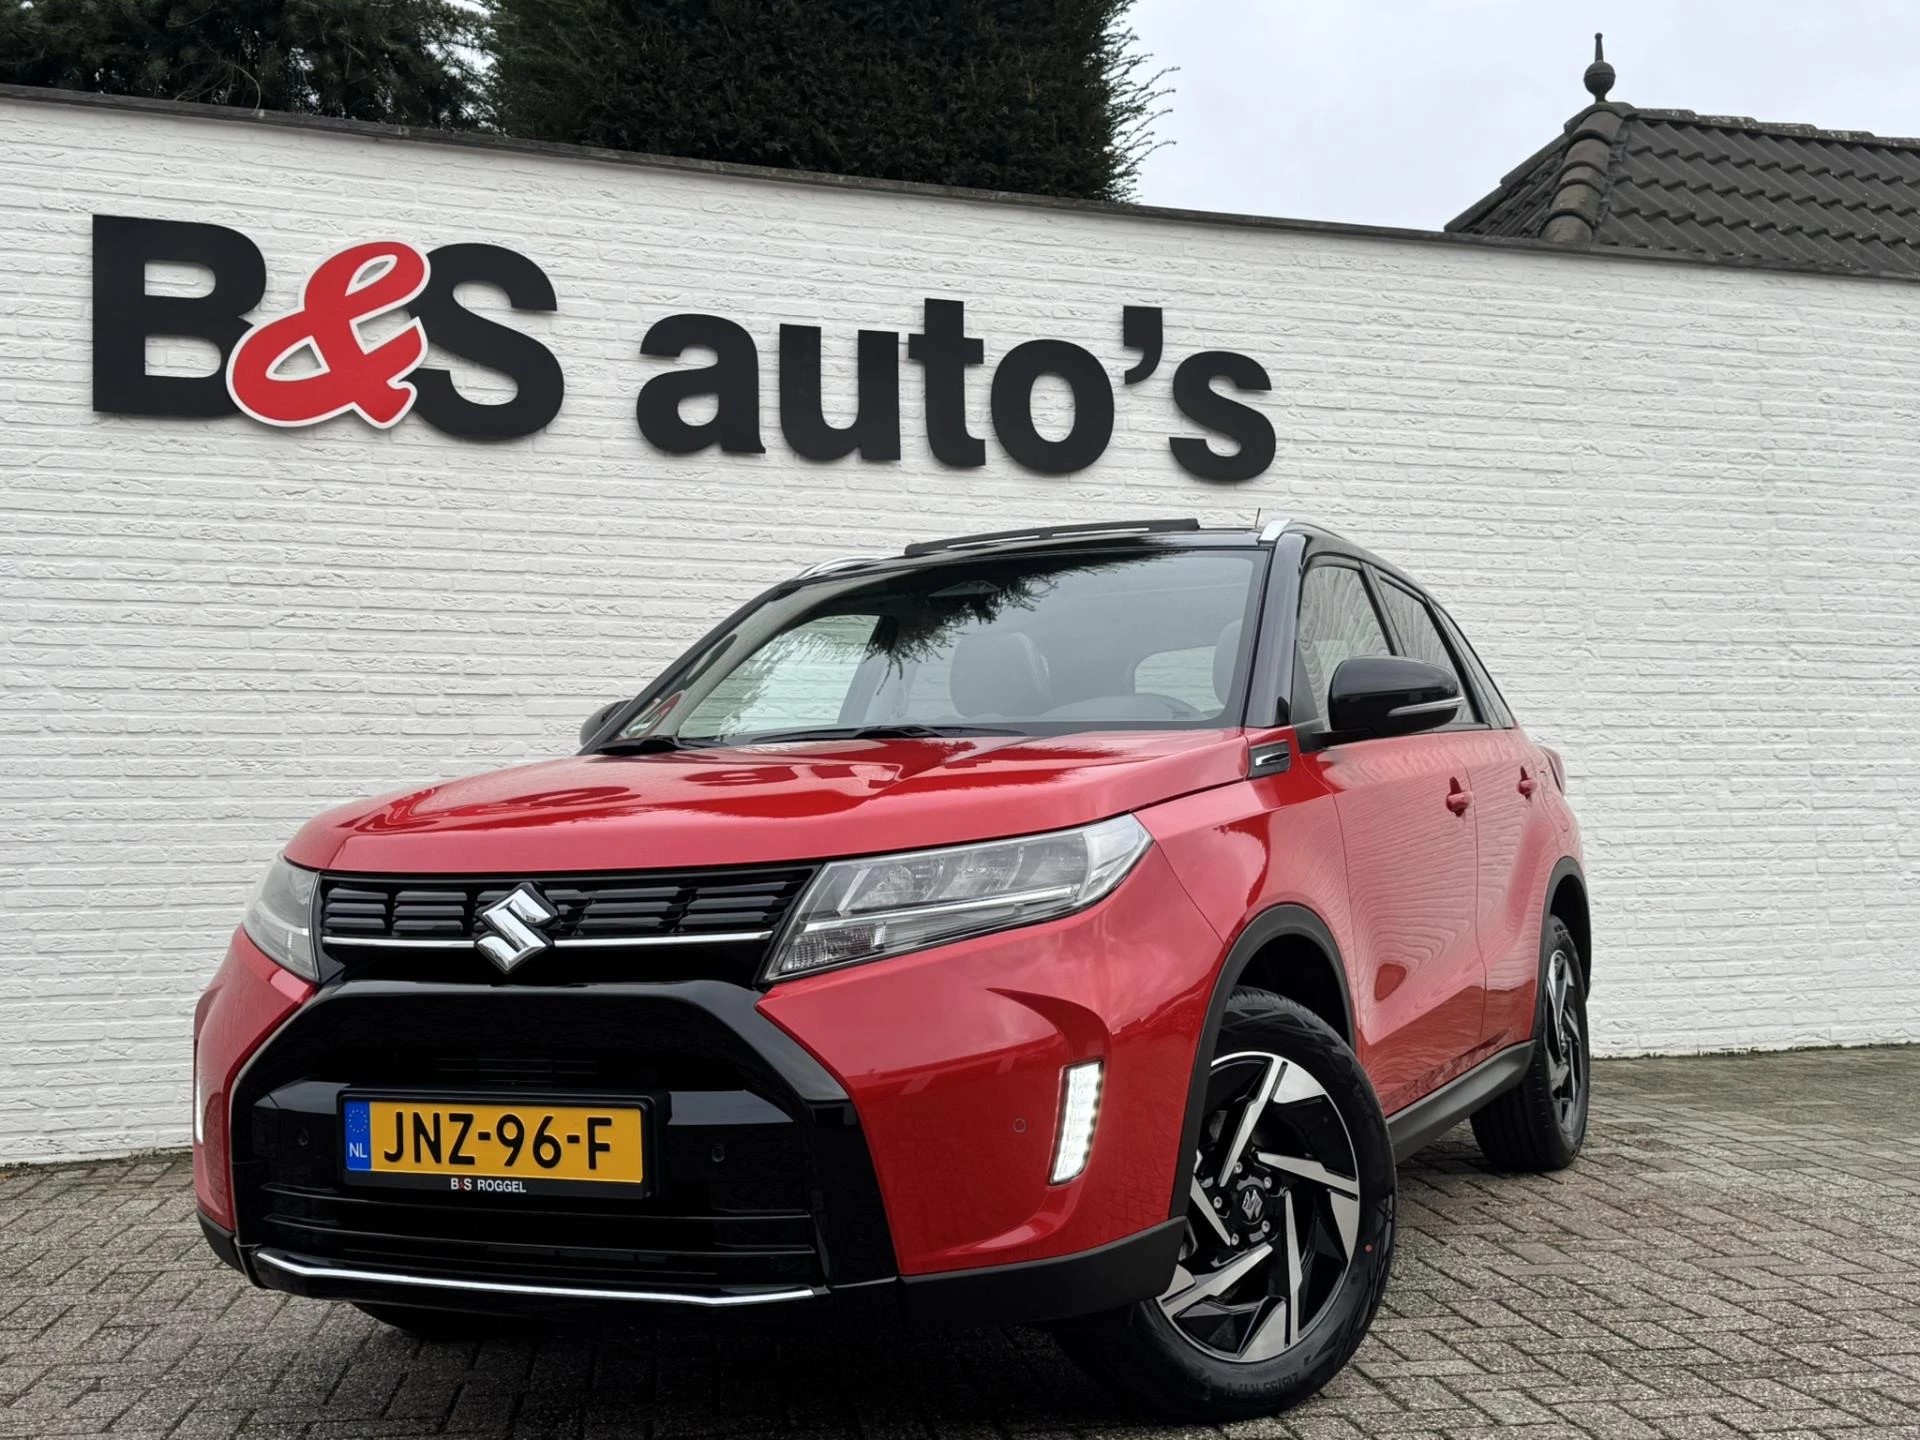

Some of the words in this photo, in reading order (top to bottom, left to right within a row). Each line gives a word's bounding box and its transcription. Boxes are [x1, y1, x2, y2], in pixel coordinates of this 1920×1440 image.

[92, 213, 565, 442] B&S
[636, 297, 1277, 482] auto's
[349, 1142, 368, 1159] NL
[383, 1111, 613, 1170] JNZ-96-F
[477, 1179, 527, 1193] ROGGEL
